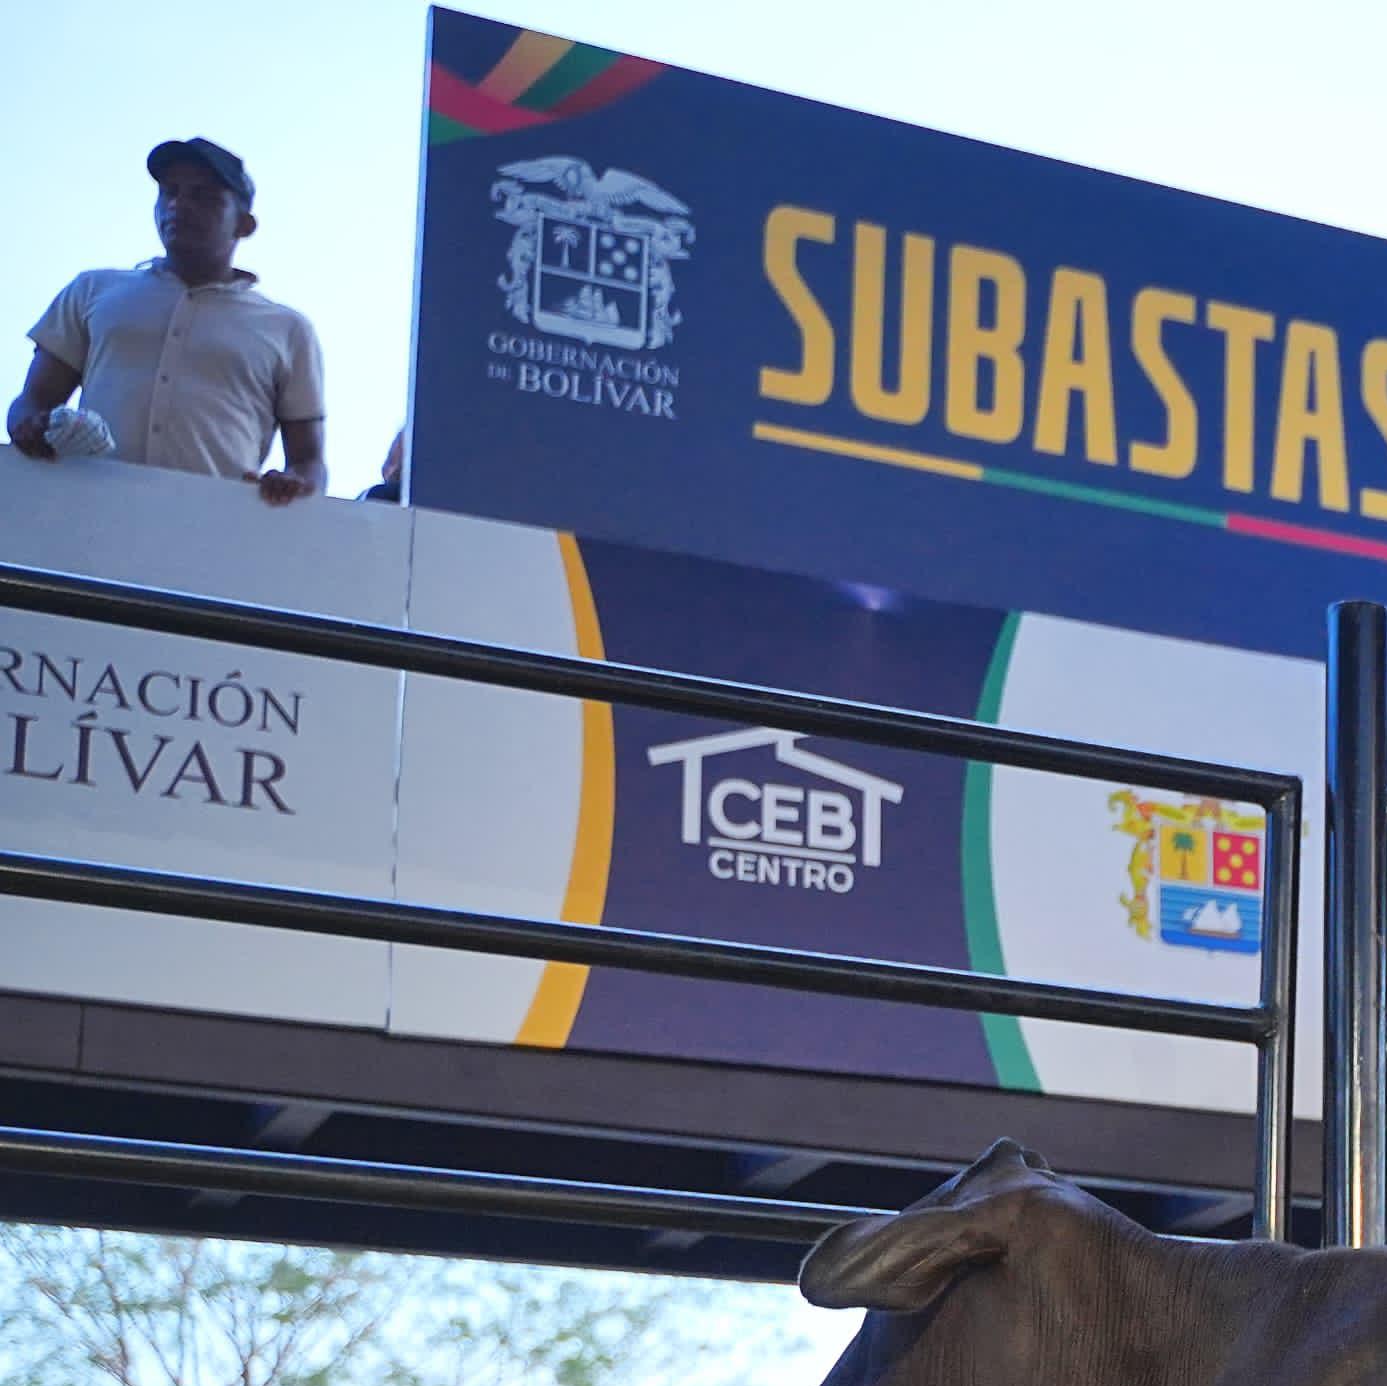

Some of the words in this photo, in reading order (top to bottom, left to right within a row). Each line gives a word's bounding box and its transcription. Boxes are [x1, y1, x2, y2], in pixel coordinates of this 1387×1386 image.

[487, 332, 680, 387] GOBERNACIÓN
[518, 362, 679, 421] BOLÍVAR
[3, 710, 297, 815] LÍVAR
[708, 779, 857, 851] CEB
[709, 850, 855, 893] CENTRO
